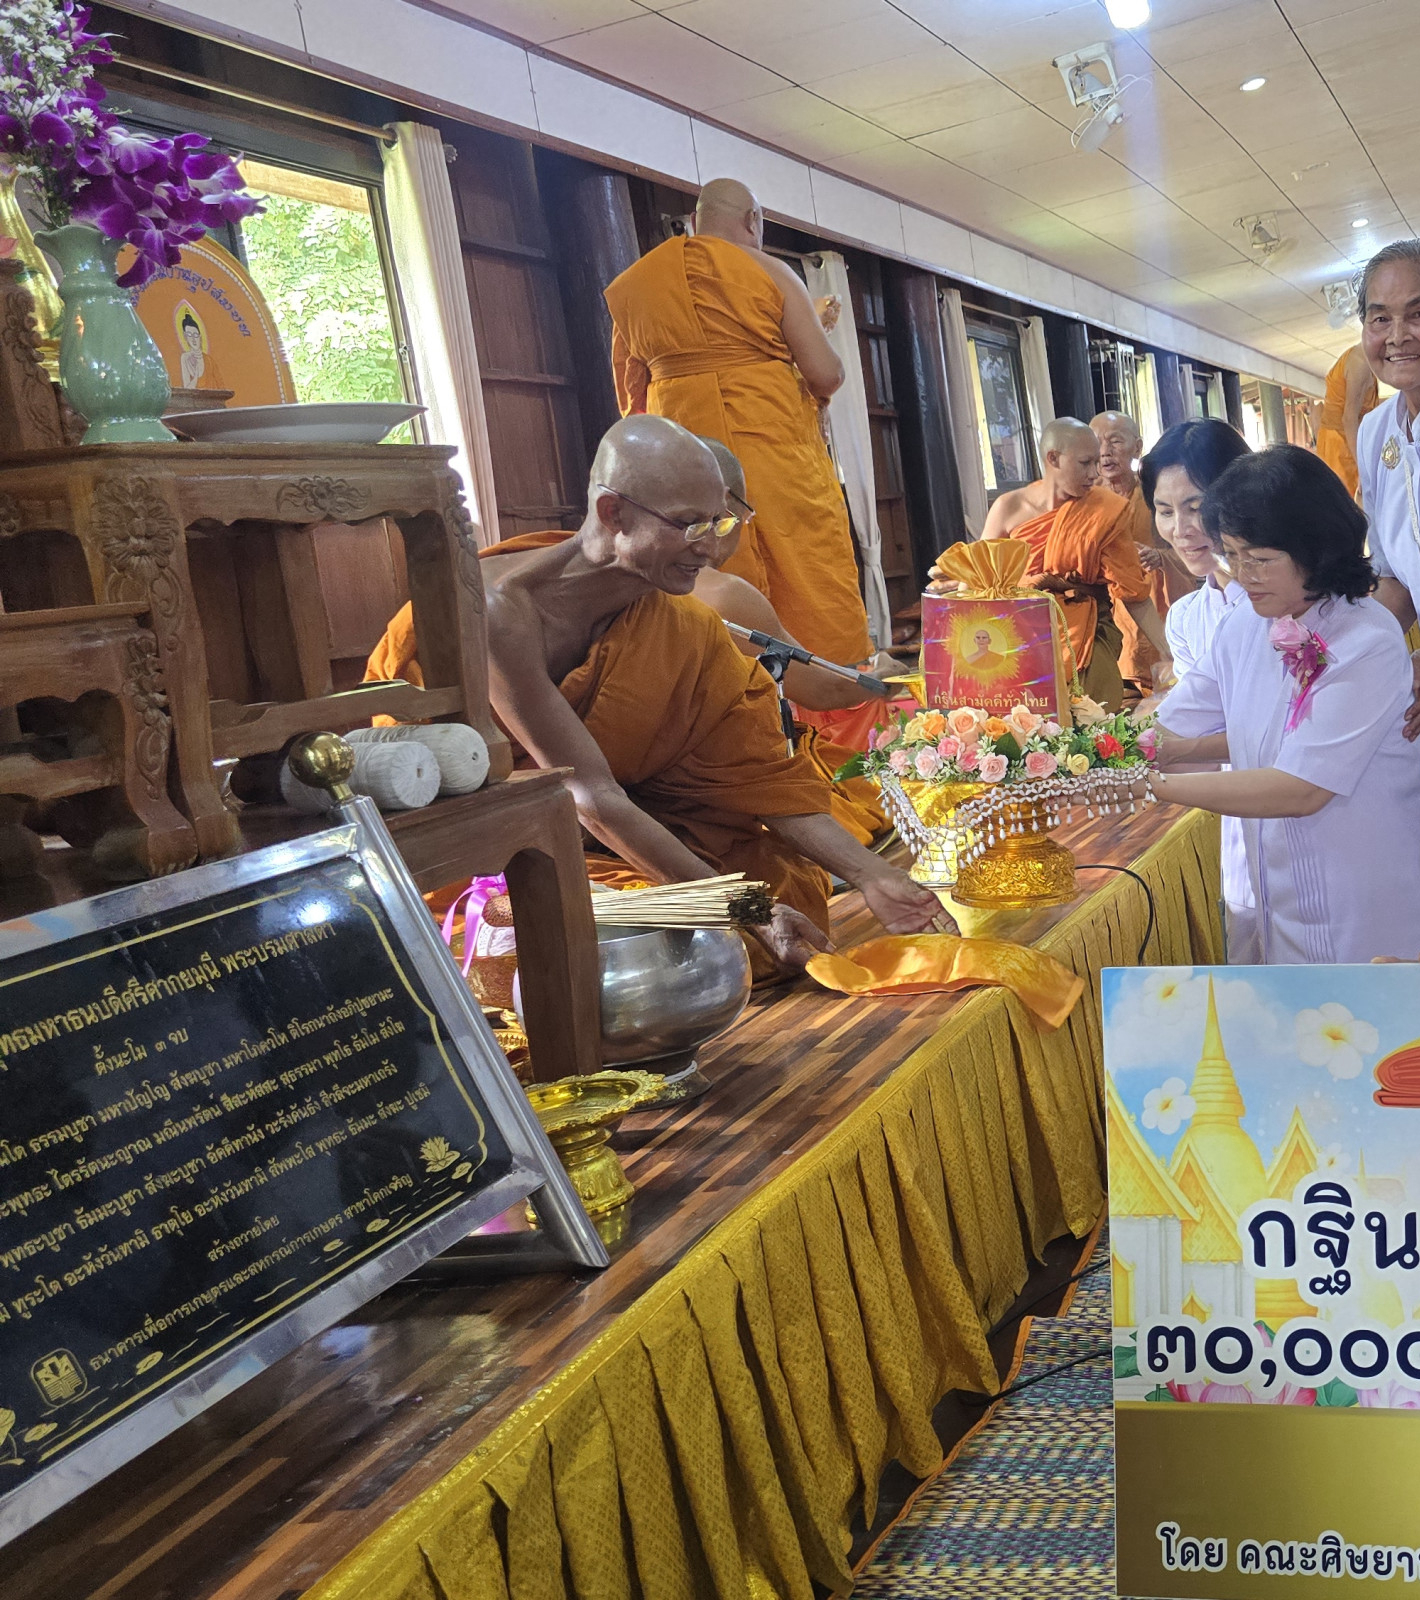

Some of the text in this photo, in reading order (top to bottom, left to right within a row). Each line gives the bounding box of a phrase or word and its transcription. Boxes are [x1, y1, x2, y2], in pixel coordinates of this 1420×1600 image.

[934, 688, 1049, 709] กฐินสามัคคีทั่วไทย
[0, 1185, 52, 1218] ะพุทธะ
[1160, 1527, 1224, 1568] โดย
